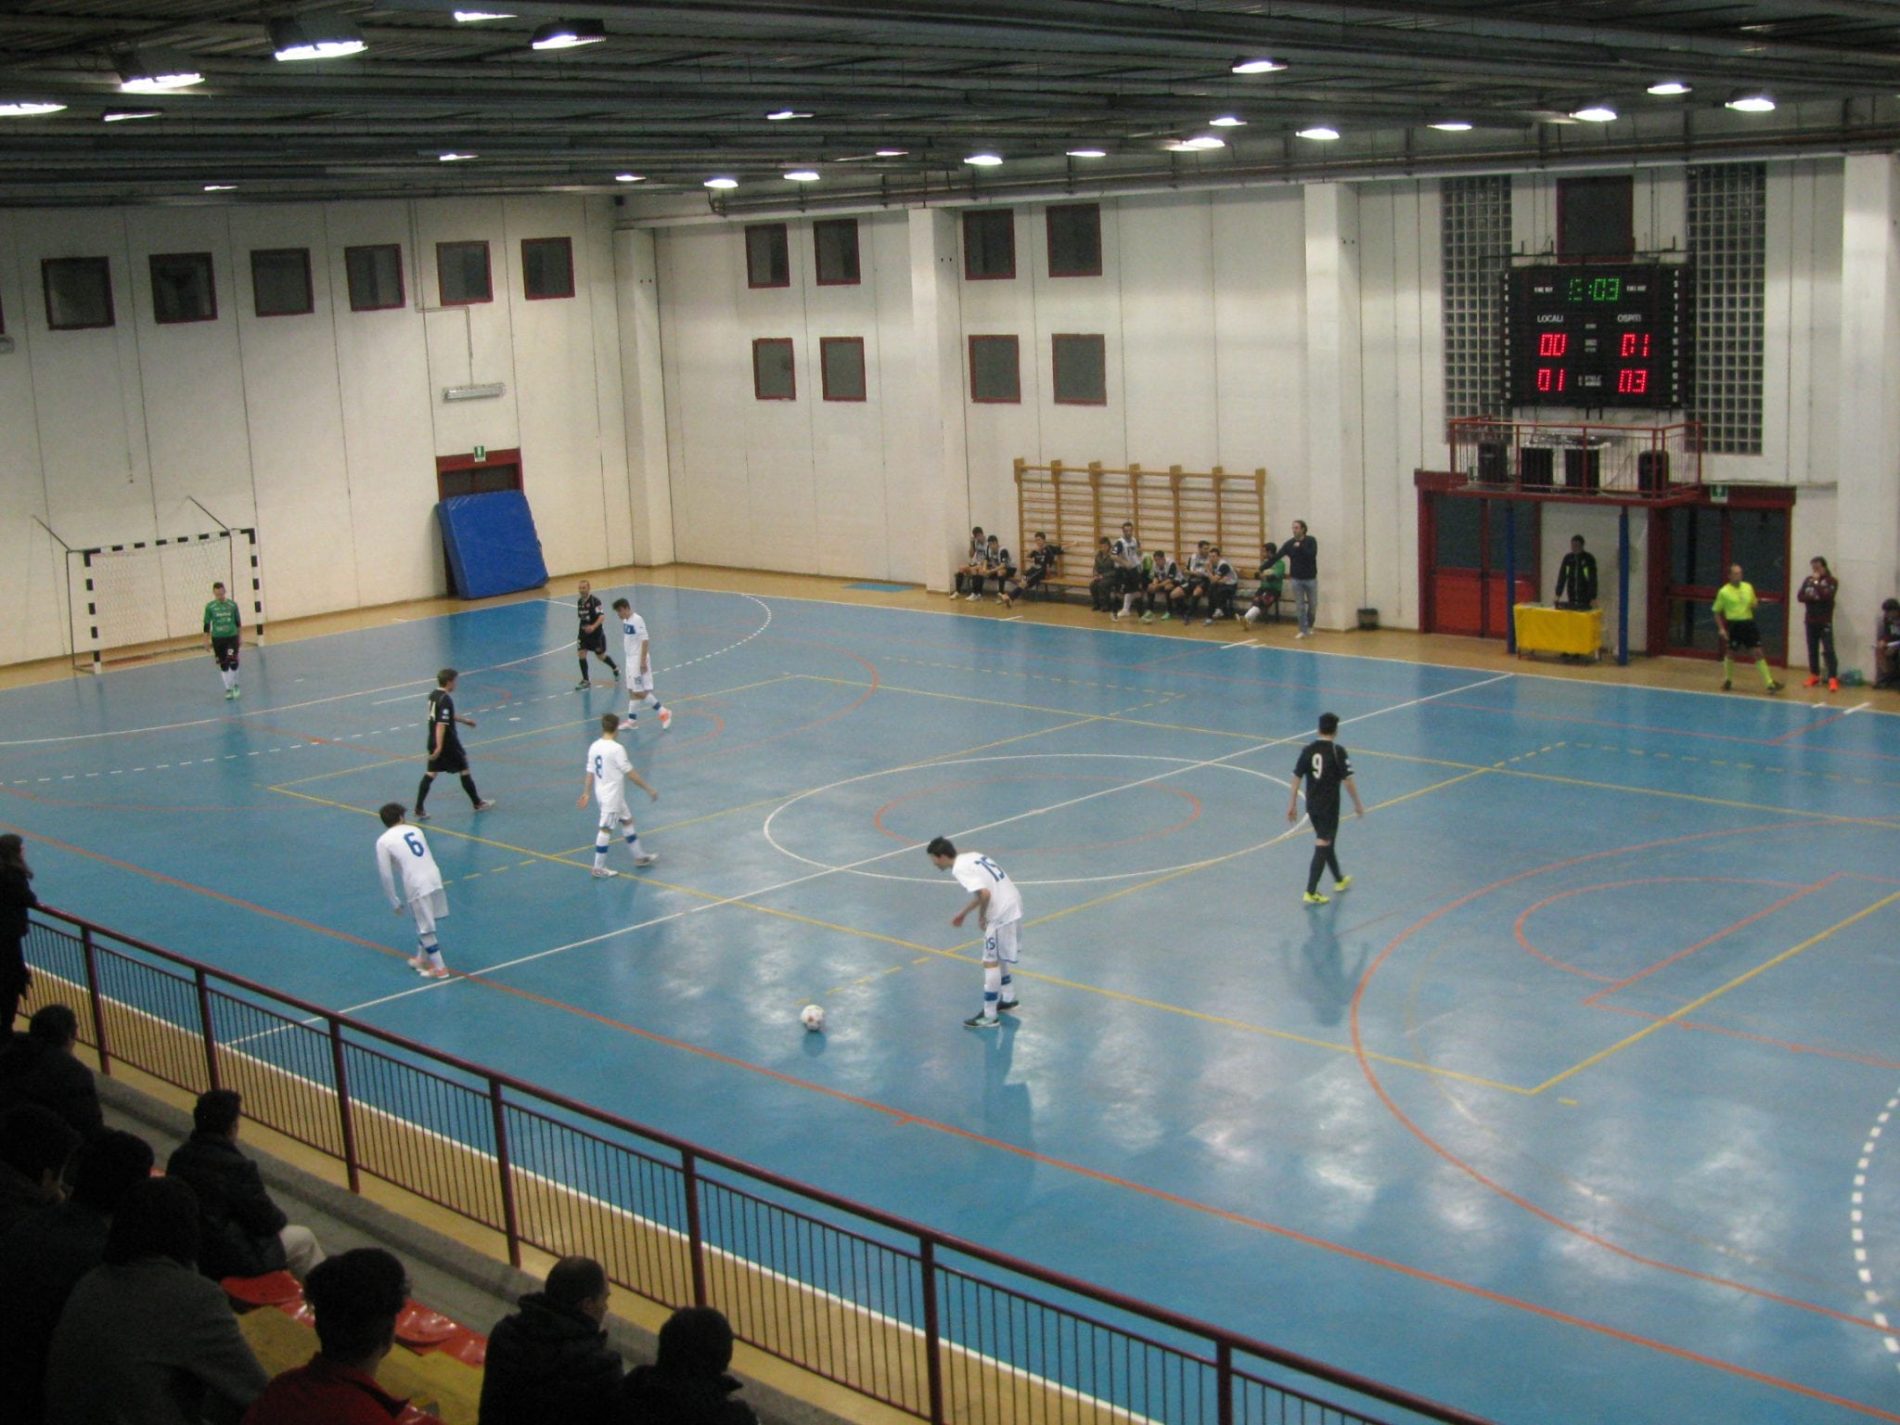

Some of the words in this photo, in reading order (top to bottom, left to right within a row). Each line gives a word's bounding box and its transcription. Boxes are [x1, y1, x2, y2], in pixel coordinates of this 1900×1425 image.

[1537, 314, 1564, 323] LOCALI
[1540, 333, 1567, 357] 00
[1621, 333, 1649, 357] 01
[1537, 368, 1565, 392] 01
[1618, 369, 1648, 393] 03
[594, 755, 603, 779] 8
[1312, 753, 1323, 779] 9
[404, 832, 425, 857] 6
